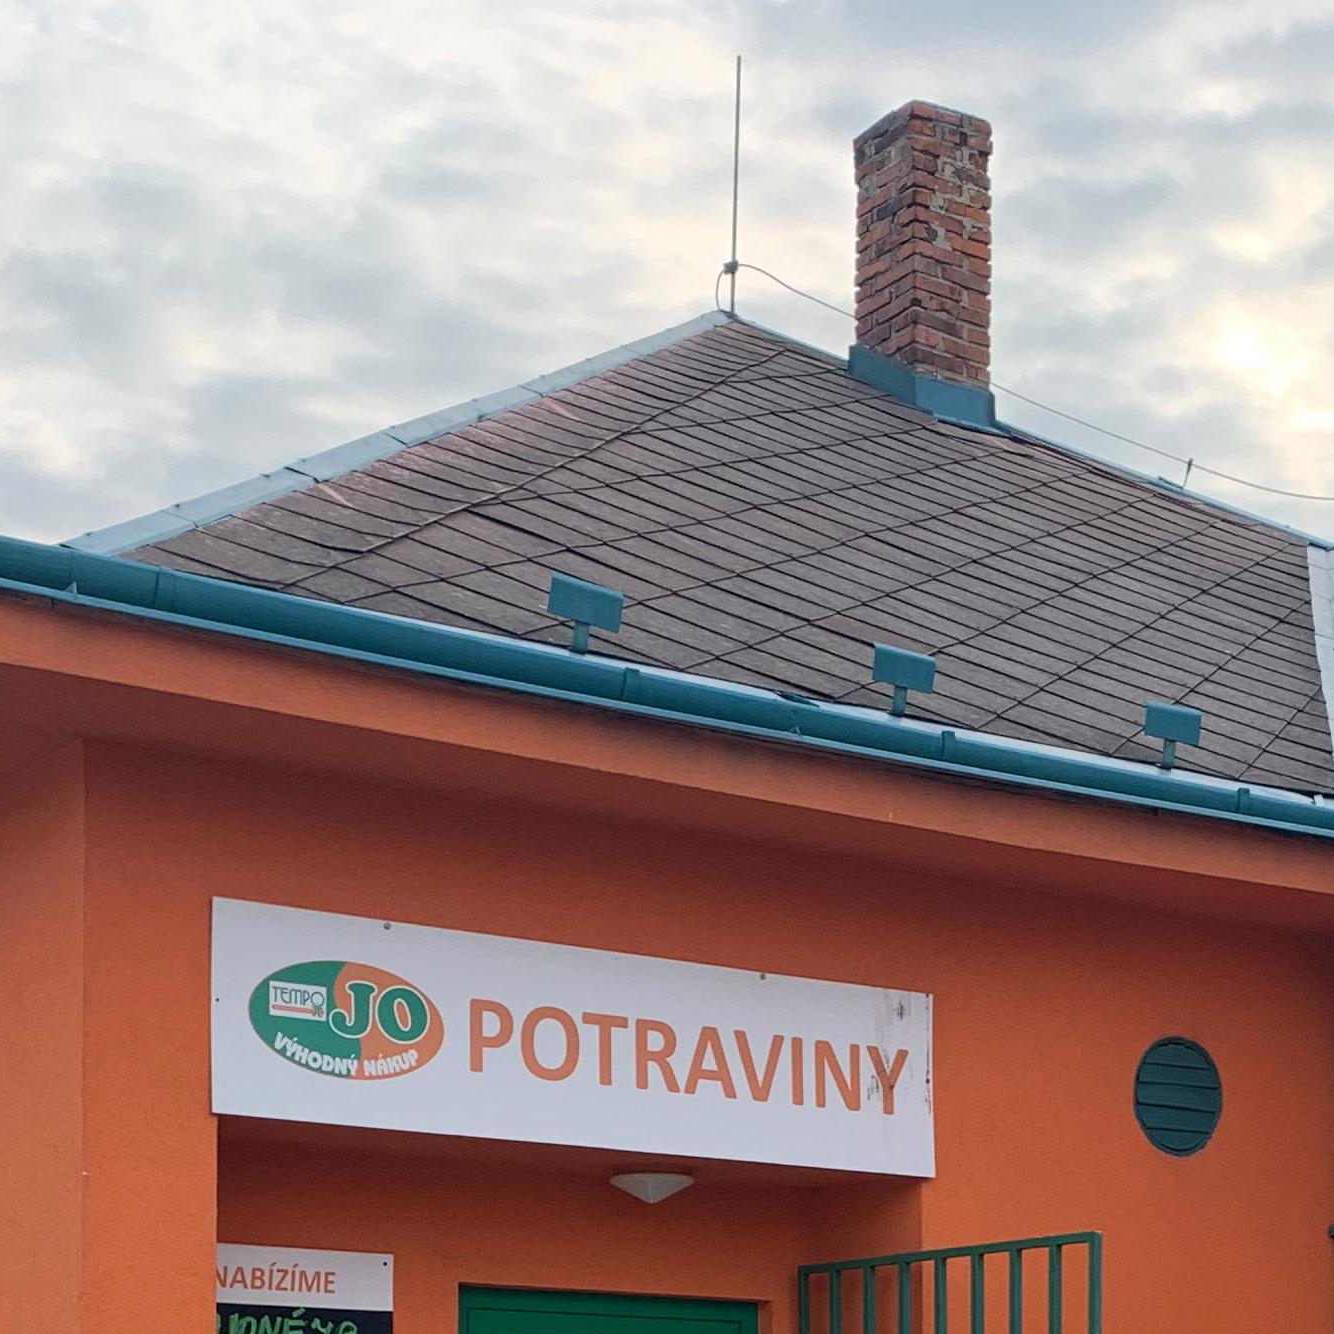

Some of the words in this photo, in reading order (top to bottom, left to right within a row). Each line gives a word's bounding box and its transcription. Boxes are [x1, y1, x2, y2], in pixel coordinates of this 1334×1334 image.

[271, 985, 327, 1008] TEMPO
[328, 979, 431, 1045] JO
[273, 1031, 359, 1076] VÝHODNÝ
[362, 1048, 419, 1077] NÁKUP
[468, 997, 910, 1115] POTRAVINY
[216, 1262, 337, 1294] NABÍZÍME
